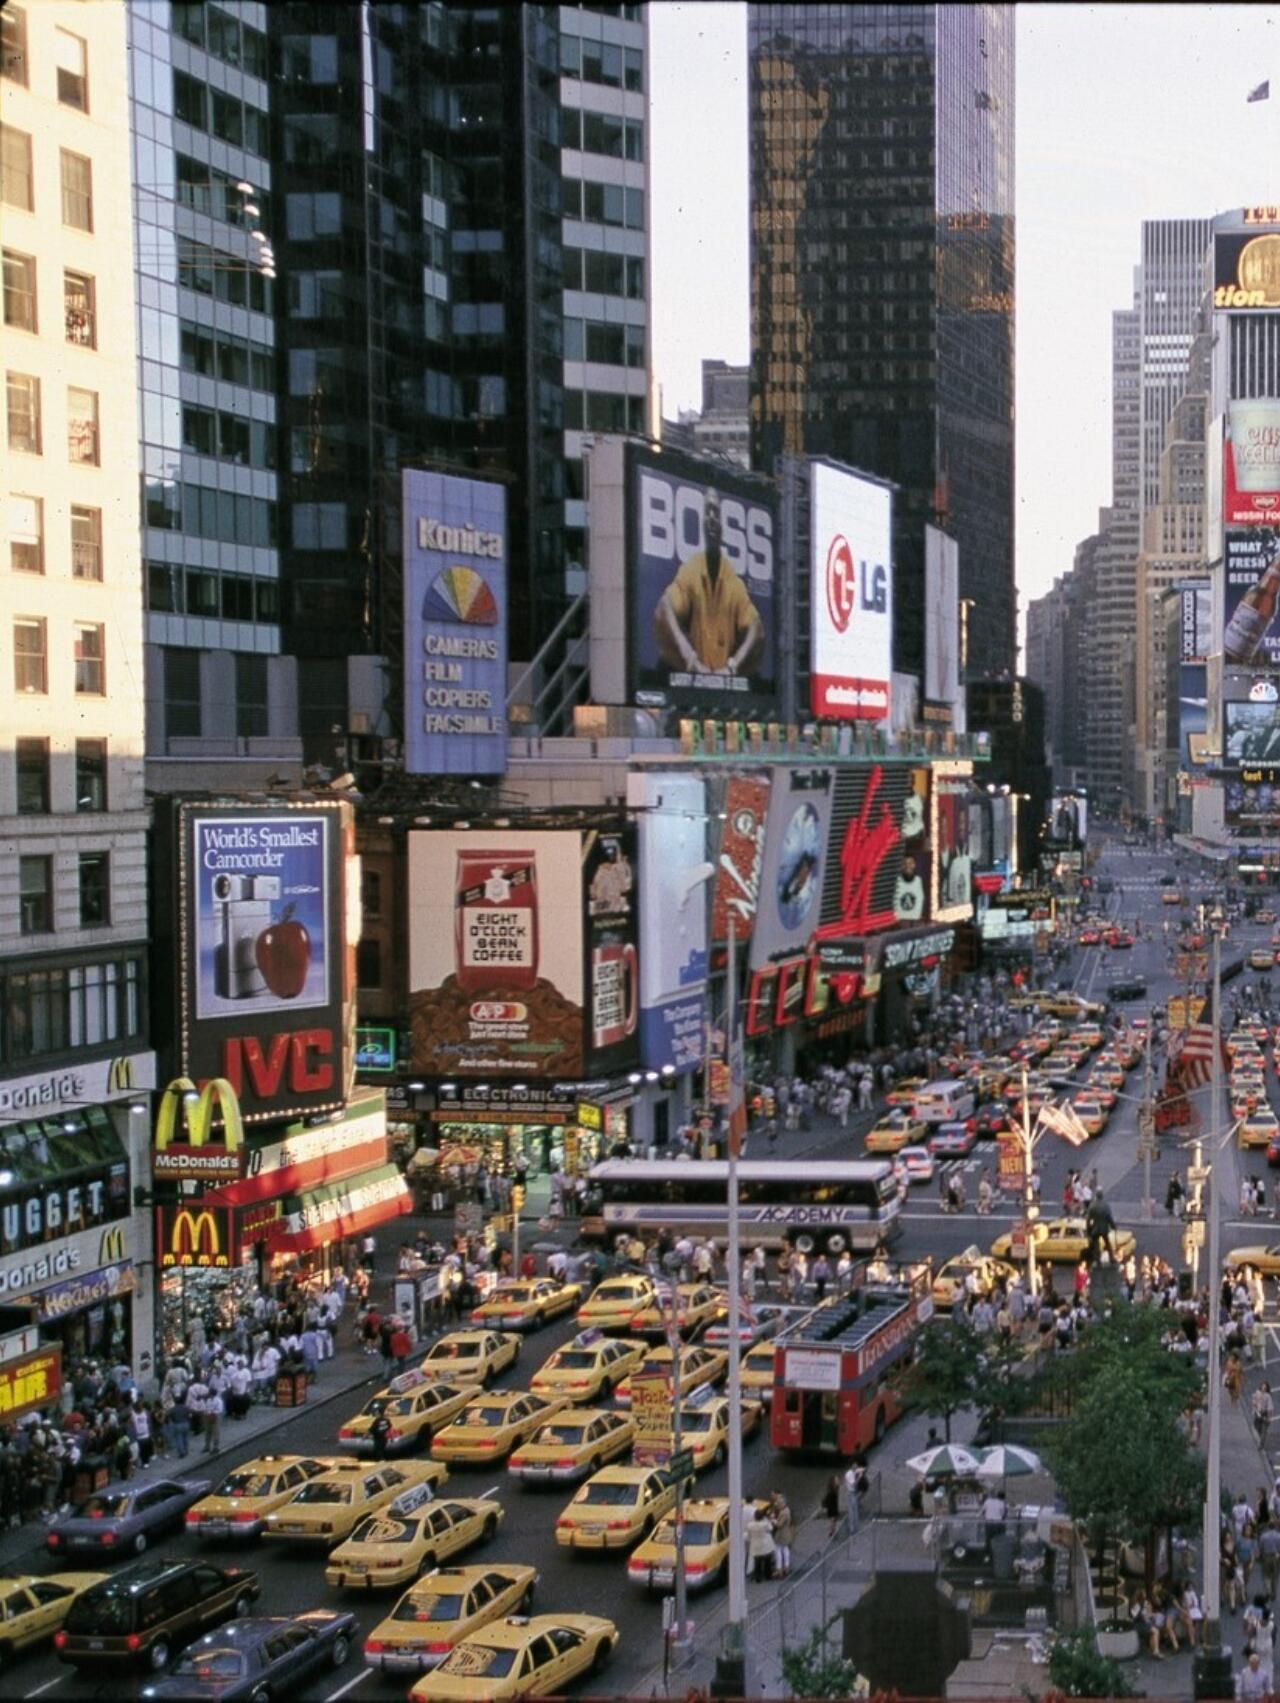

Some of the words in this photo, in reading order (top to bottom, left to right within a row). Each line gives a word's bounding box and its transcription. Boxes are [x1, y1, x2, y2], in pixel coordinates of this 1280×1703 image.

[1233, 511, 1264, 521] NISSIN
[641, 474, 773, 580] BOSS
[418, 517, 502, 558] Konica
[1229, 542, 1262, 553] WHAT
[1229, 557, 1266, 568] FRESH
[861, 560, 886, 614] LG
[1229, 573, 1259, 583] BEER
[425, 635, 497, 660] CAMERAS
[425, 661, 462, 682] FILM
[425, 687, 492, 710] COPIERS
[425, 712, 502, 735] FACSIMILE
[204, 827, 257, 848] World's
[260, 826, 319, 847] Smallest
[204, 848, 284, 869] Camcorder
[477, 913, 518, 924] EIGHT
[470, 926, 526, 936] O'CLOCK
[478, 938, 517, 948] BEAN
[473, 950, 523, 961] COFFEE
[197, 1029, 333, 1103] JVC
[156, 1155, 239, 1168] McDonald's
[758, 1207, 846, 1222] ACADEMY
